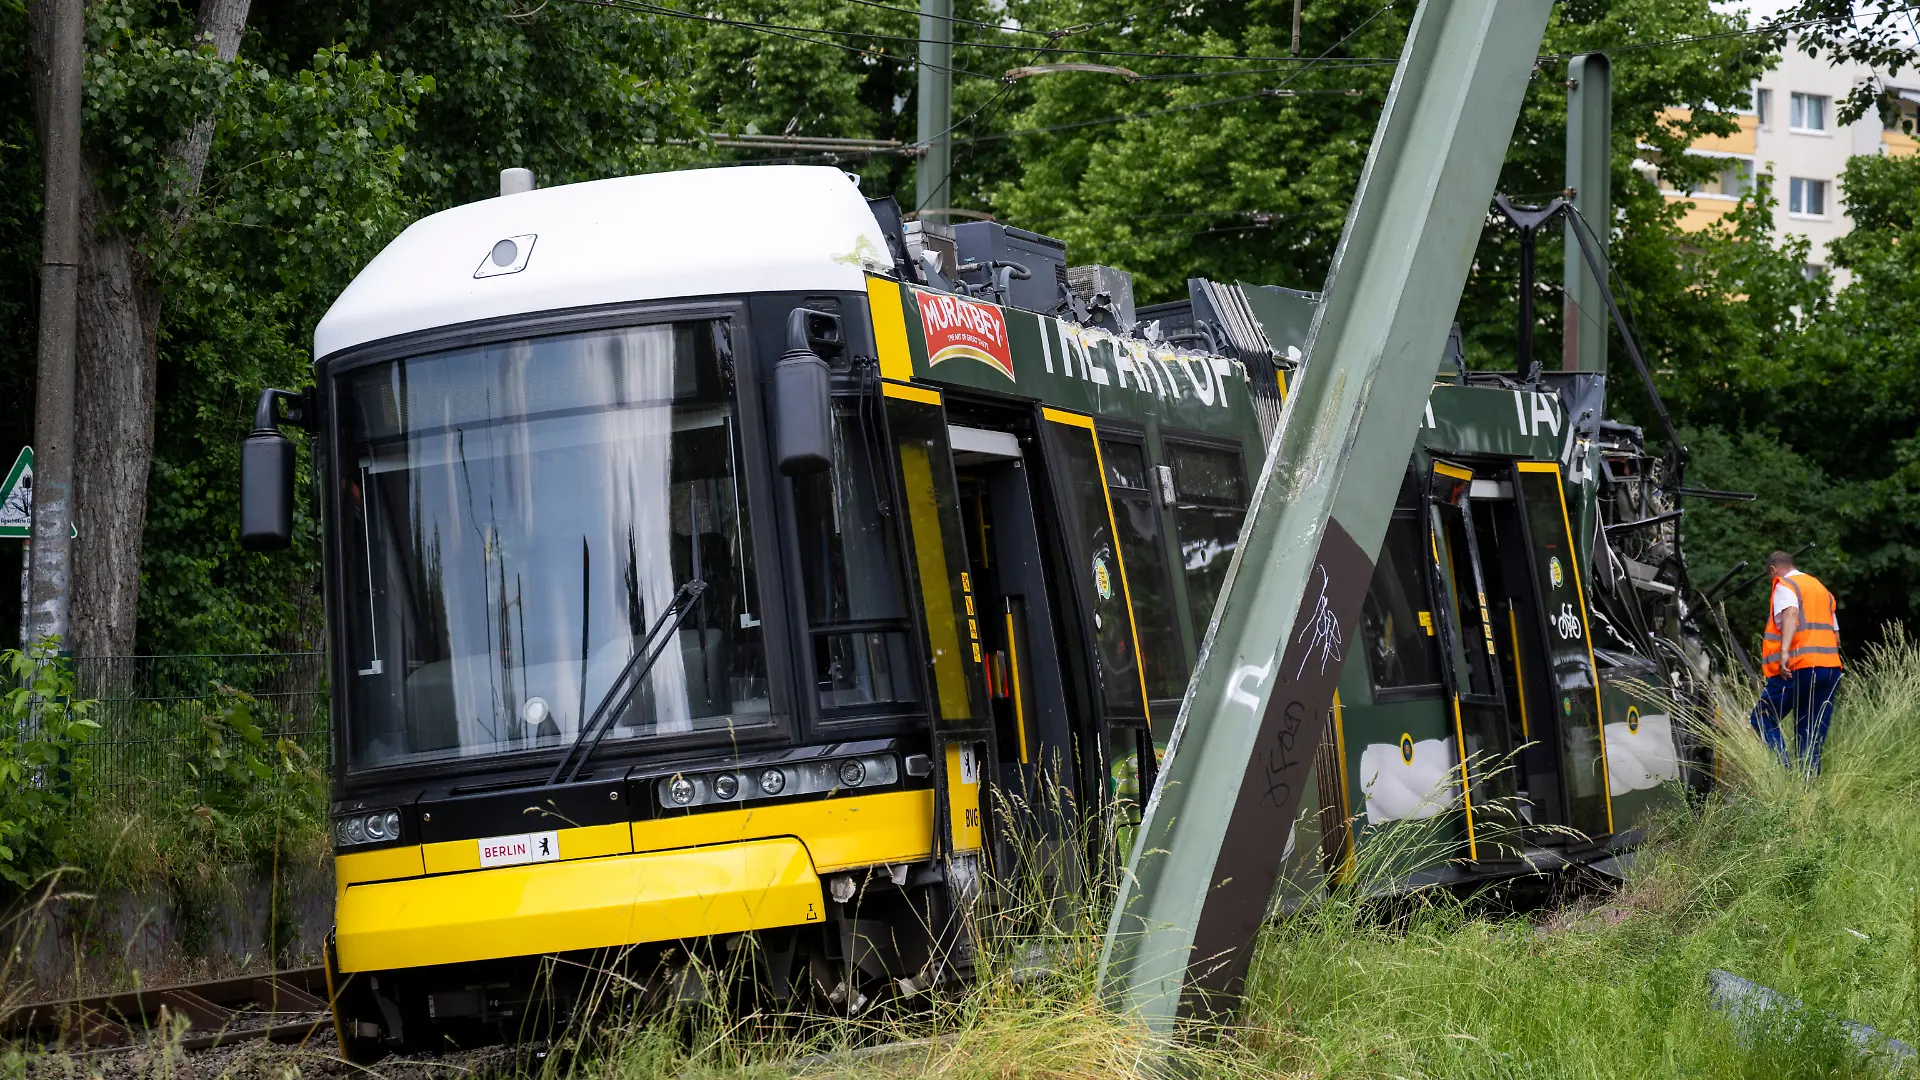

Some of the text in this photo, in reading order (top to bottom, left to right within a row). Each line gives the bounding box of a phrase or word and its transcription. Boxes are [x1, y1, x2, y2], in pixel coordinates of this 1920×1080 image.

[923, 298, 1002, 347] MURATBEY
[965, 808, 979, 827] BVG
[484, 844, 526, 858] BERLIN
